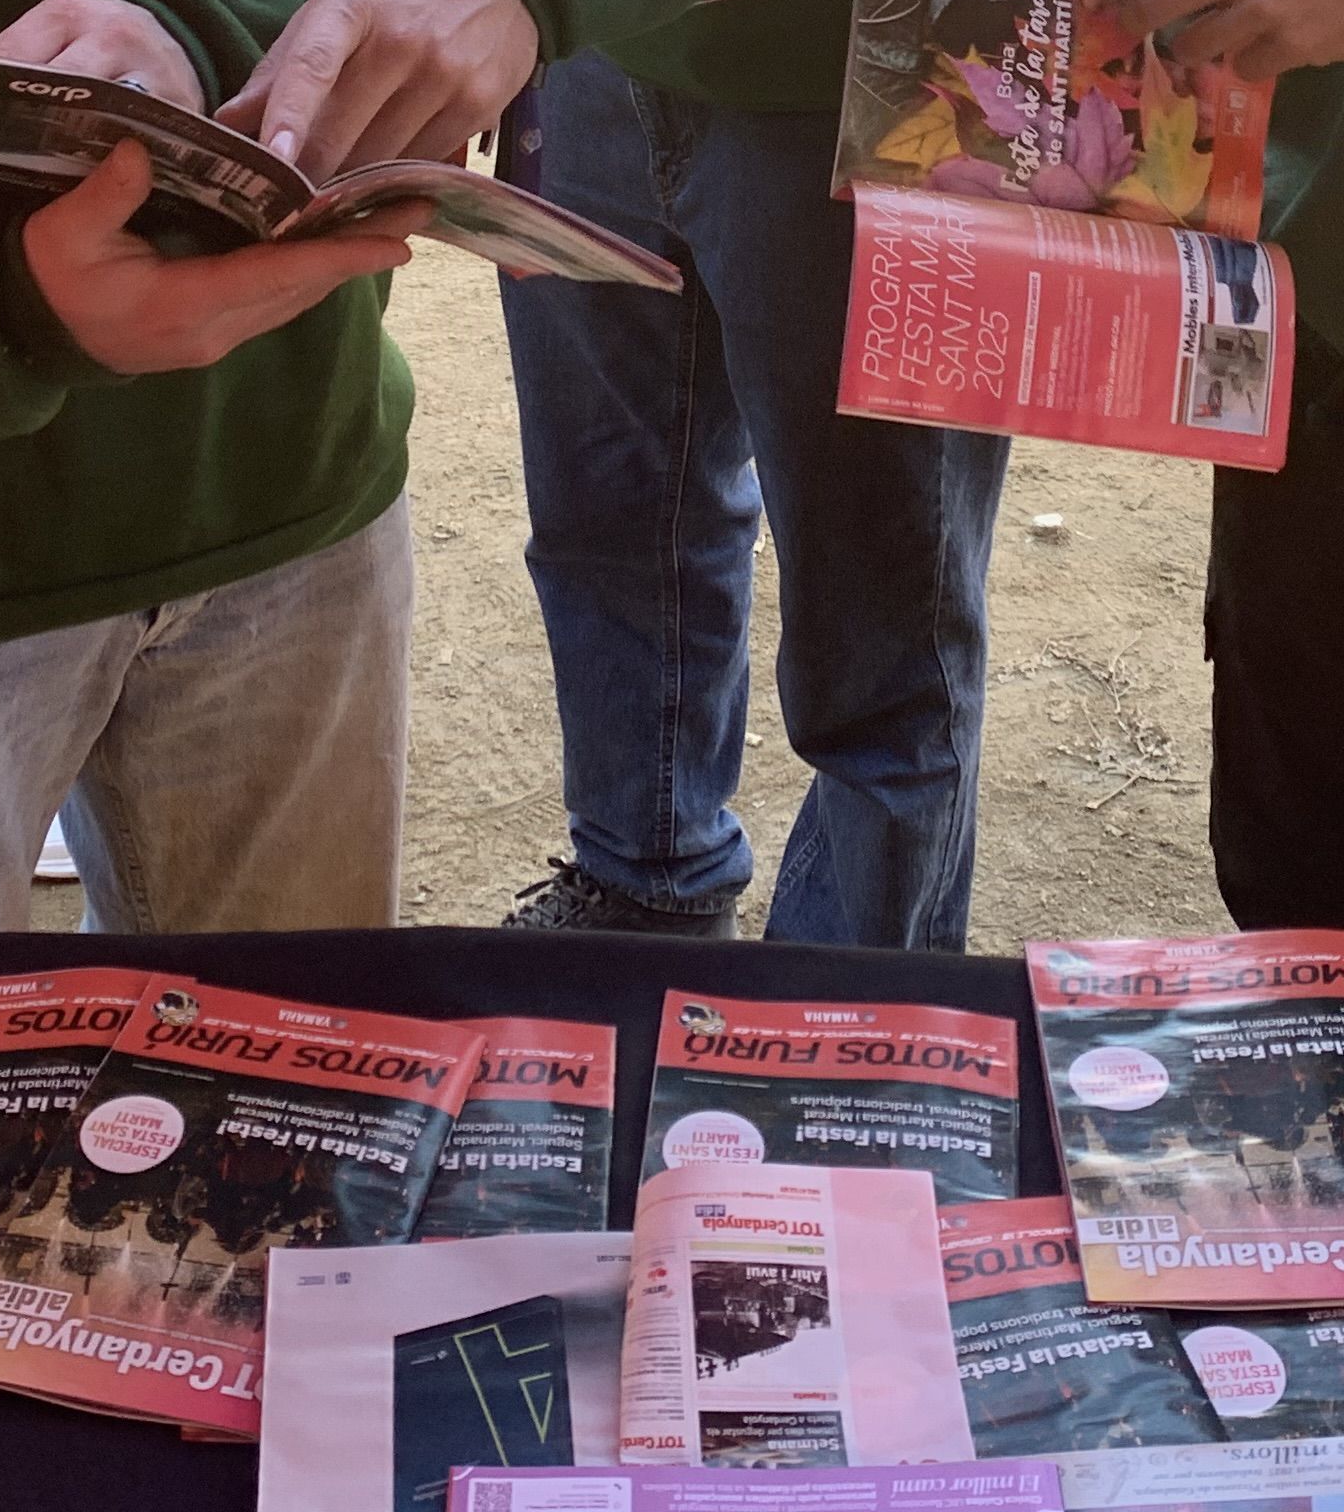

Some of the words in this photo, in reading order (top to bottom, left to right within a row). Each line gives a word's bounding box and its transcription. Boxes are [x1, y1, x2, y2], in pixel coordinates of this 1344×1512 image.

[996, 46, 1016, 99] Bona
[1019, 48, 1047, 79] la
[1015, 84, 1043, 119] de
[1047, 71, 1069, 135] SANT
[998, 124, 1044, 193] Festa
[1046, 139, 1064, 166] de
[899, 282, 939, 387] FESTA
[1181, 299, 1199, 355] Mobles
[936, 289, 974, 392] SANT
[973, 306, 1010, 399] 2025
[1059, 974, 1191, 1005] FURIÓ
[278, 1009, 332, 1029] YAMAHA
[804, 1010, 859, 1023] YAMAHA
[144, 1021, 283, 1063] FURIÓ
[683, 1033, 821, 1064] FURIÓ
[1269, 1041, 1292, 1060] la
[837, 1041, 992, 1077] MOTOS
[1191, 1044, 1266, 1064] Festa!
[289, 1046, 448, 1088] MOTOS
[27, 1097, 50, 1112] la
[227, 1093, 287, 1112] populars
[114, 1111, 163, 1130] MARTÍ
[232, 1107, 282, 1124] Mercat
[289, 1112, 360, 1138] Martinada
[88, 1121, 129, 1140] SANT
[131, 1129, 176, 1148] FESTA
[216, 1118, 293, 1148] Festa!
[795, 1125, 870, 1146] Festa!
[878, 1130, 898, 1149] la
[92, 1136, 162, 1160] ESPECIAL
[295, 1133, 318, 1153] la
[669, 1145, 710, 1158] SANT
[712, 1146, 759, 1160] FESTA
[903, 1130, 992, 1157] Esclata
[320, 1136, 409, 1173] Esclata
[702, 1216, 788, 1234] Cerdanyola
[790, 1222, 824, 1237] TOT
[746, 1267, 779, 1279] avui
[789, 1269, 822, 1281] Ahir
[656, 1436, 685, 1448] TOT
